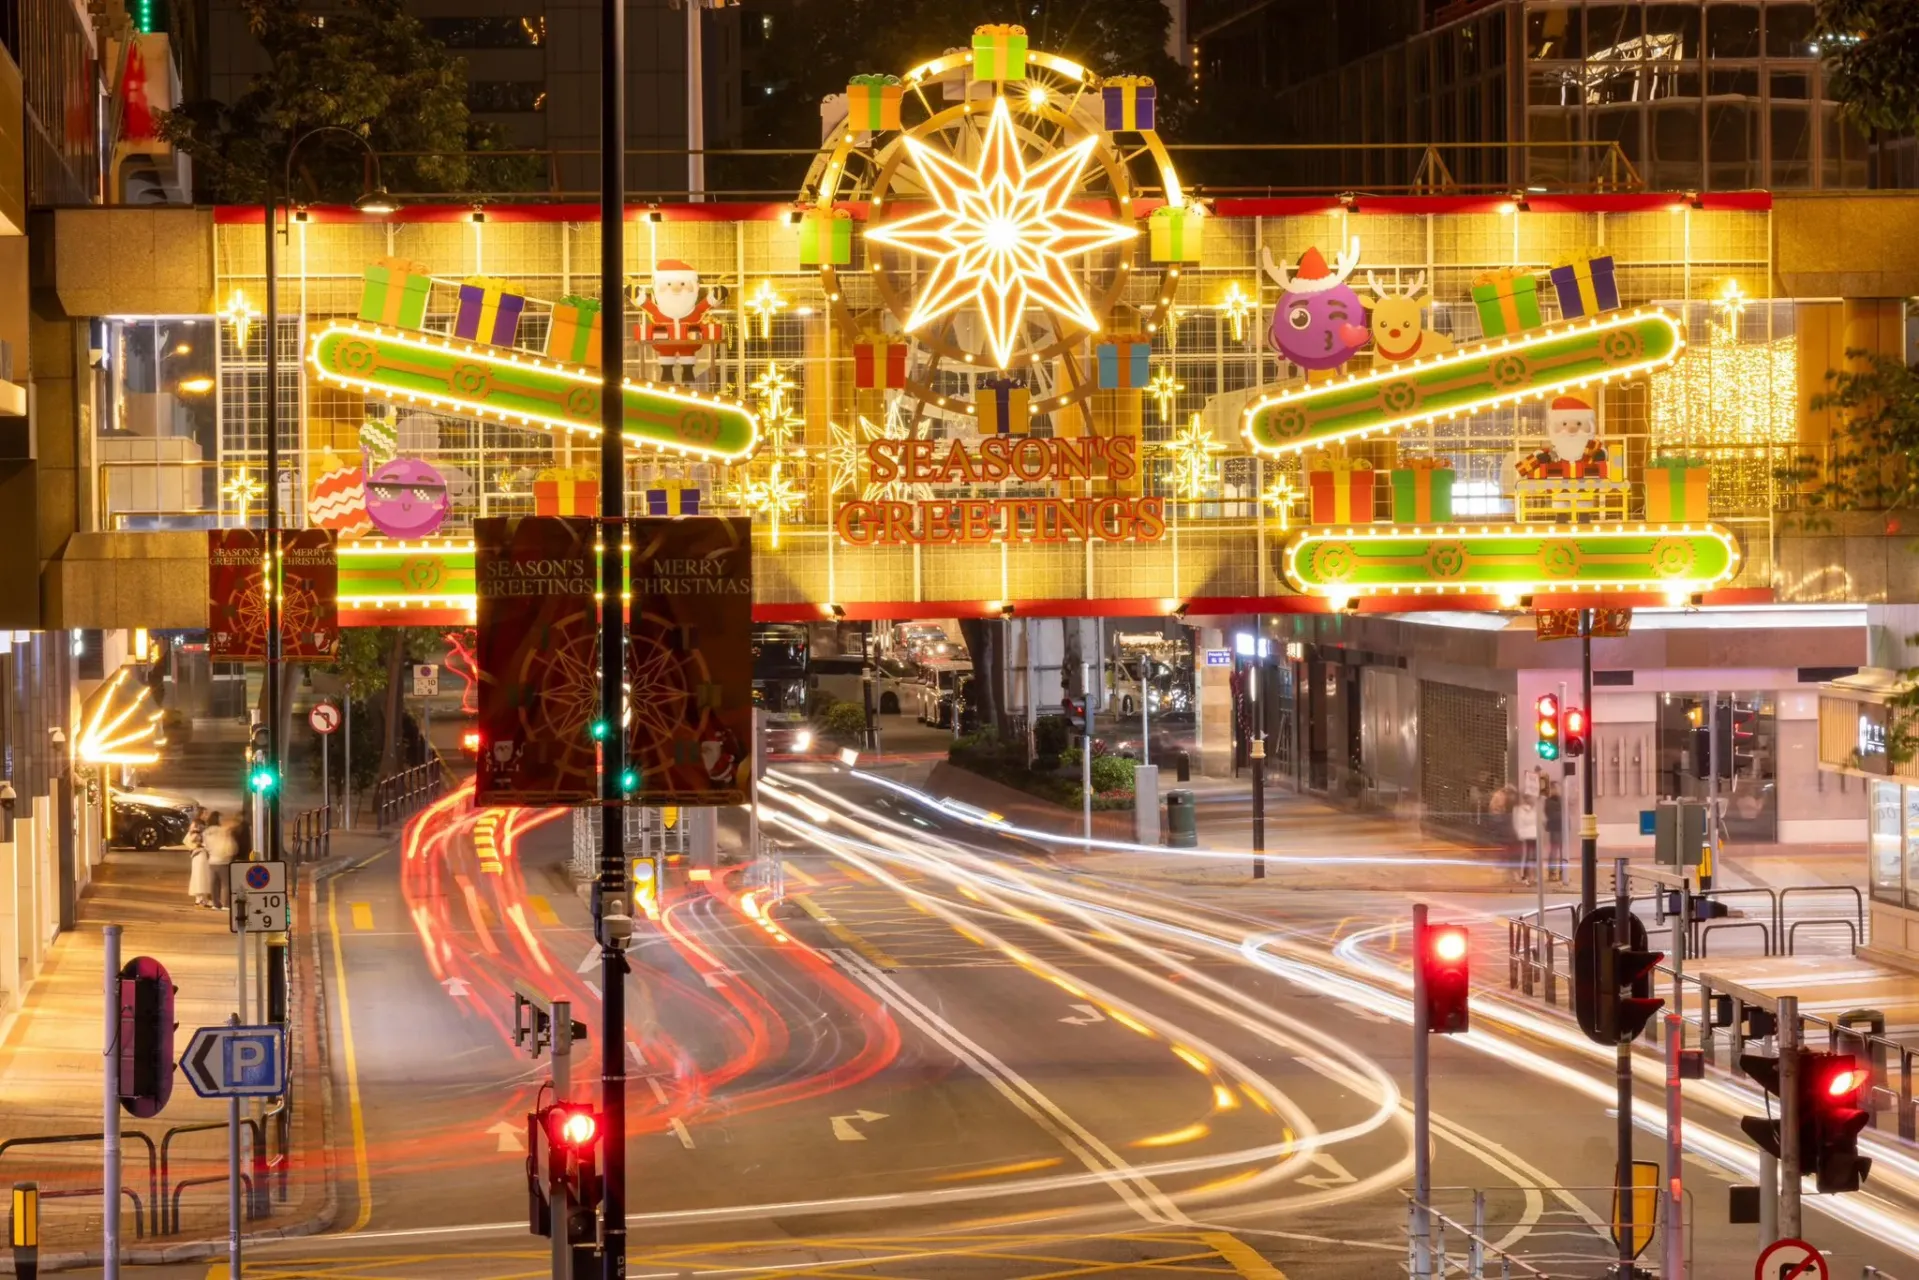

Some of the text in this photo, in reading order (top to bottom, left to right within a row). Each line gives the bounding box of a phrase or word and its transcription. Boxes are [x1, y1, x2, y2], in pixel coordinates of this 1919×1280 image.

[867, 435, 1137, 483] SEASON'S
[836, 496, 1166, 545] GREETINGS
[213, 548, 260, 557] SEASON'S
[292, 548, 327, 557] MERRY
[209, 557, 263, 566] GREETINGS
[282, 557, 337, 566] CHRISTMAS
[486, 559, 584, 578] SEASON'S
[653, 559, 727, 576] MERRY
[477, 578, 594, 597] GREETINGS
[631, 578, 750, 595] CHRISTMAS
[262, 895, 280, 908] 10
[262, 915, 272, 928] 9
[233, 1041, 264, 1083] P
